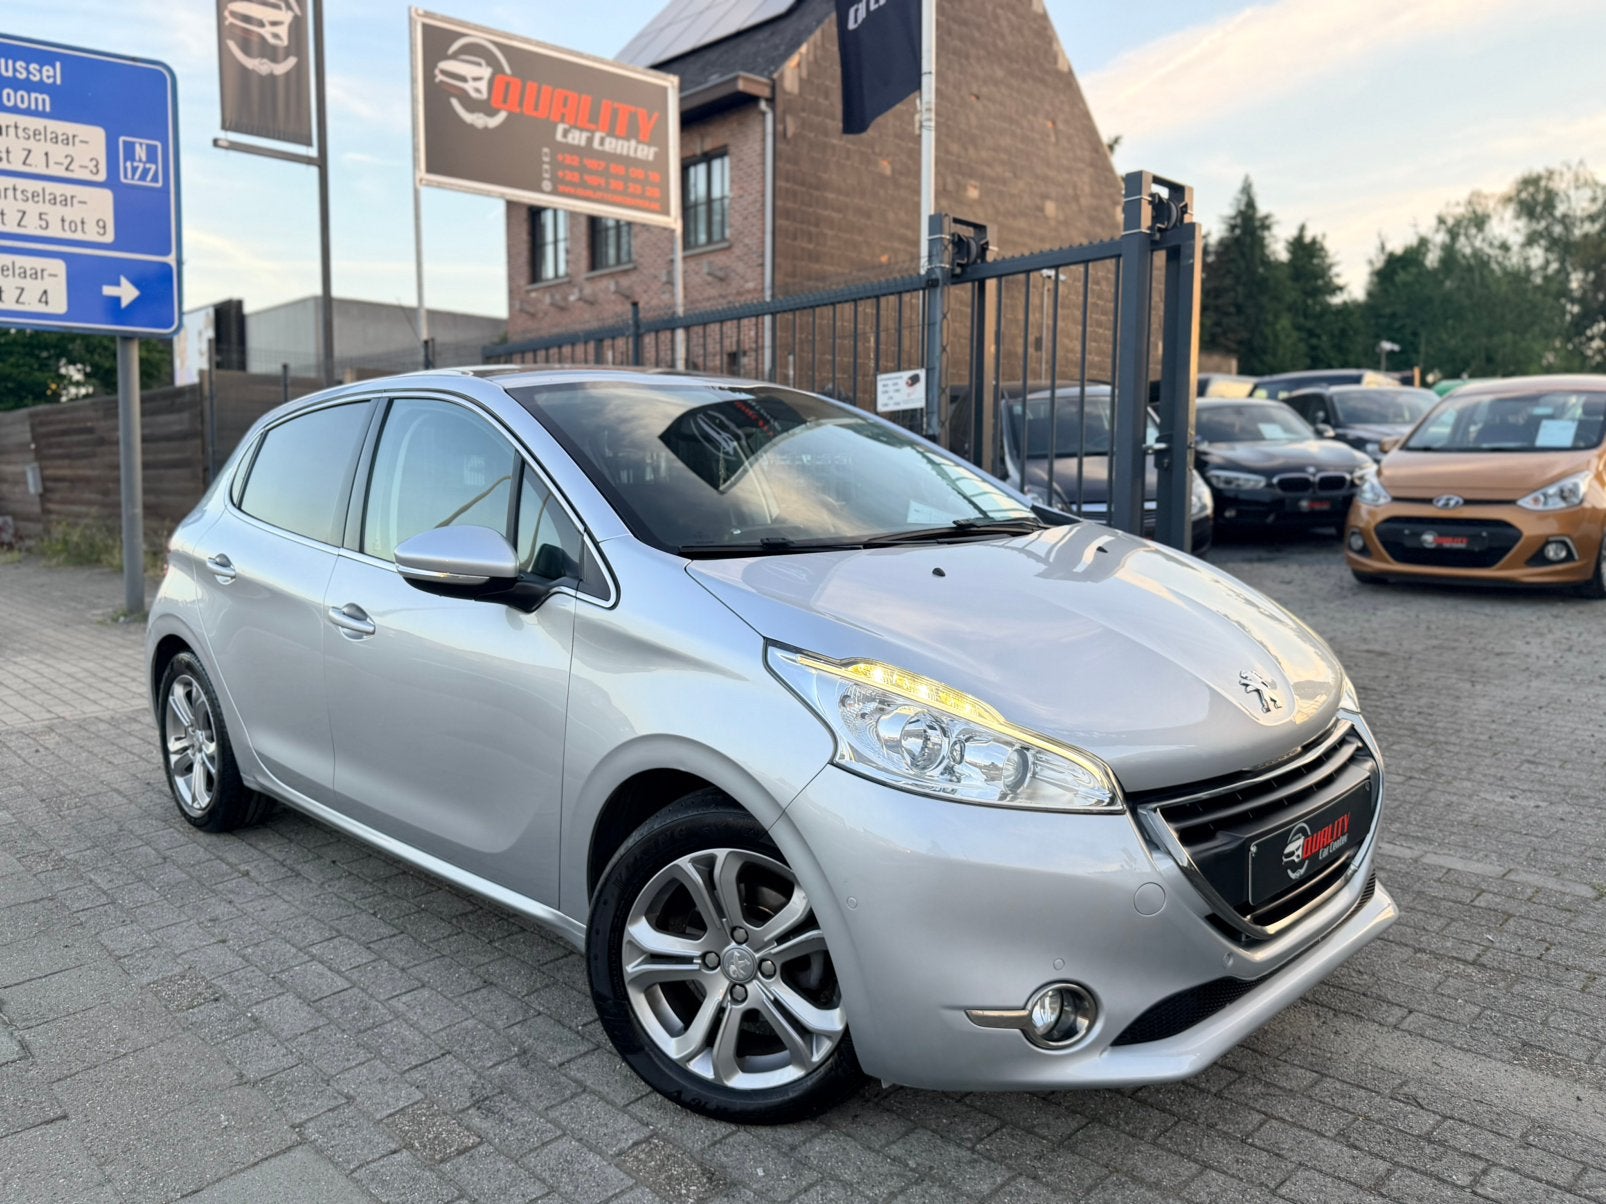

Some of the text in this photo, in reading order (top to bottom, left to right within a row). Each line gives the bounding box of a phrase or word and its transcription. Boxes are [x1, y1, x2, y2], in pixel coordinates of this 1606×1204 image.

[0, 58, 62, 85] ussel
[2, 87, 51, 113] oom
[490, 73, 660, 143] QUALITY
[0, 121, 90, 147] rtselaar-
[555, 122, 659, 161] Car Center
[134, 142, 147, 163] N
[125, 160, 157, 183] 177
[0, 184, 88, 207] rtselaar-
[60, 214, 87, 235] tot
[96, 218, 107, 237] 9
[1303, 813, 1351, 860] QUALITY
